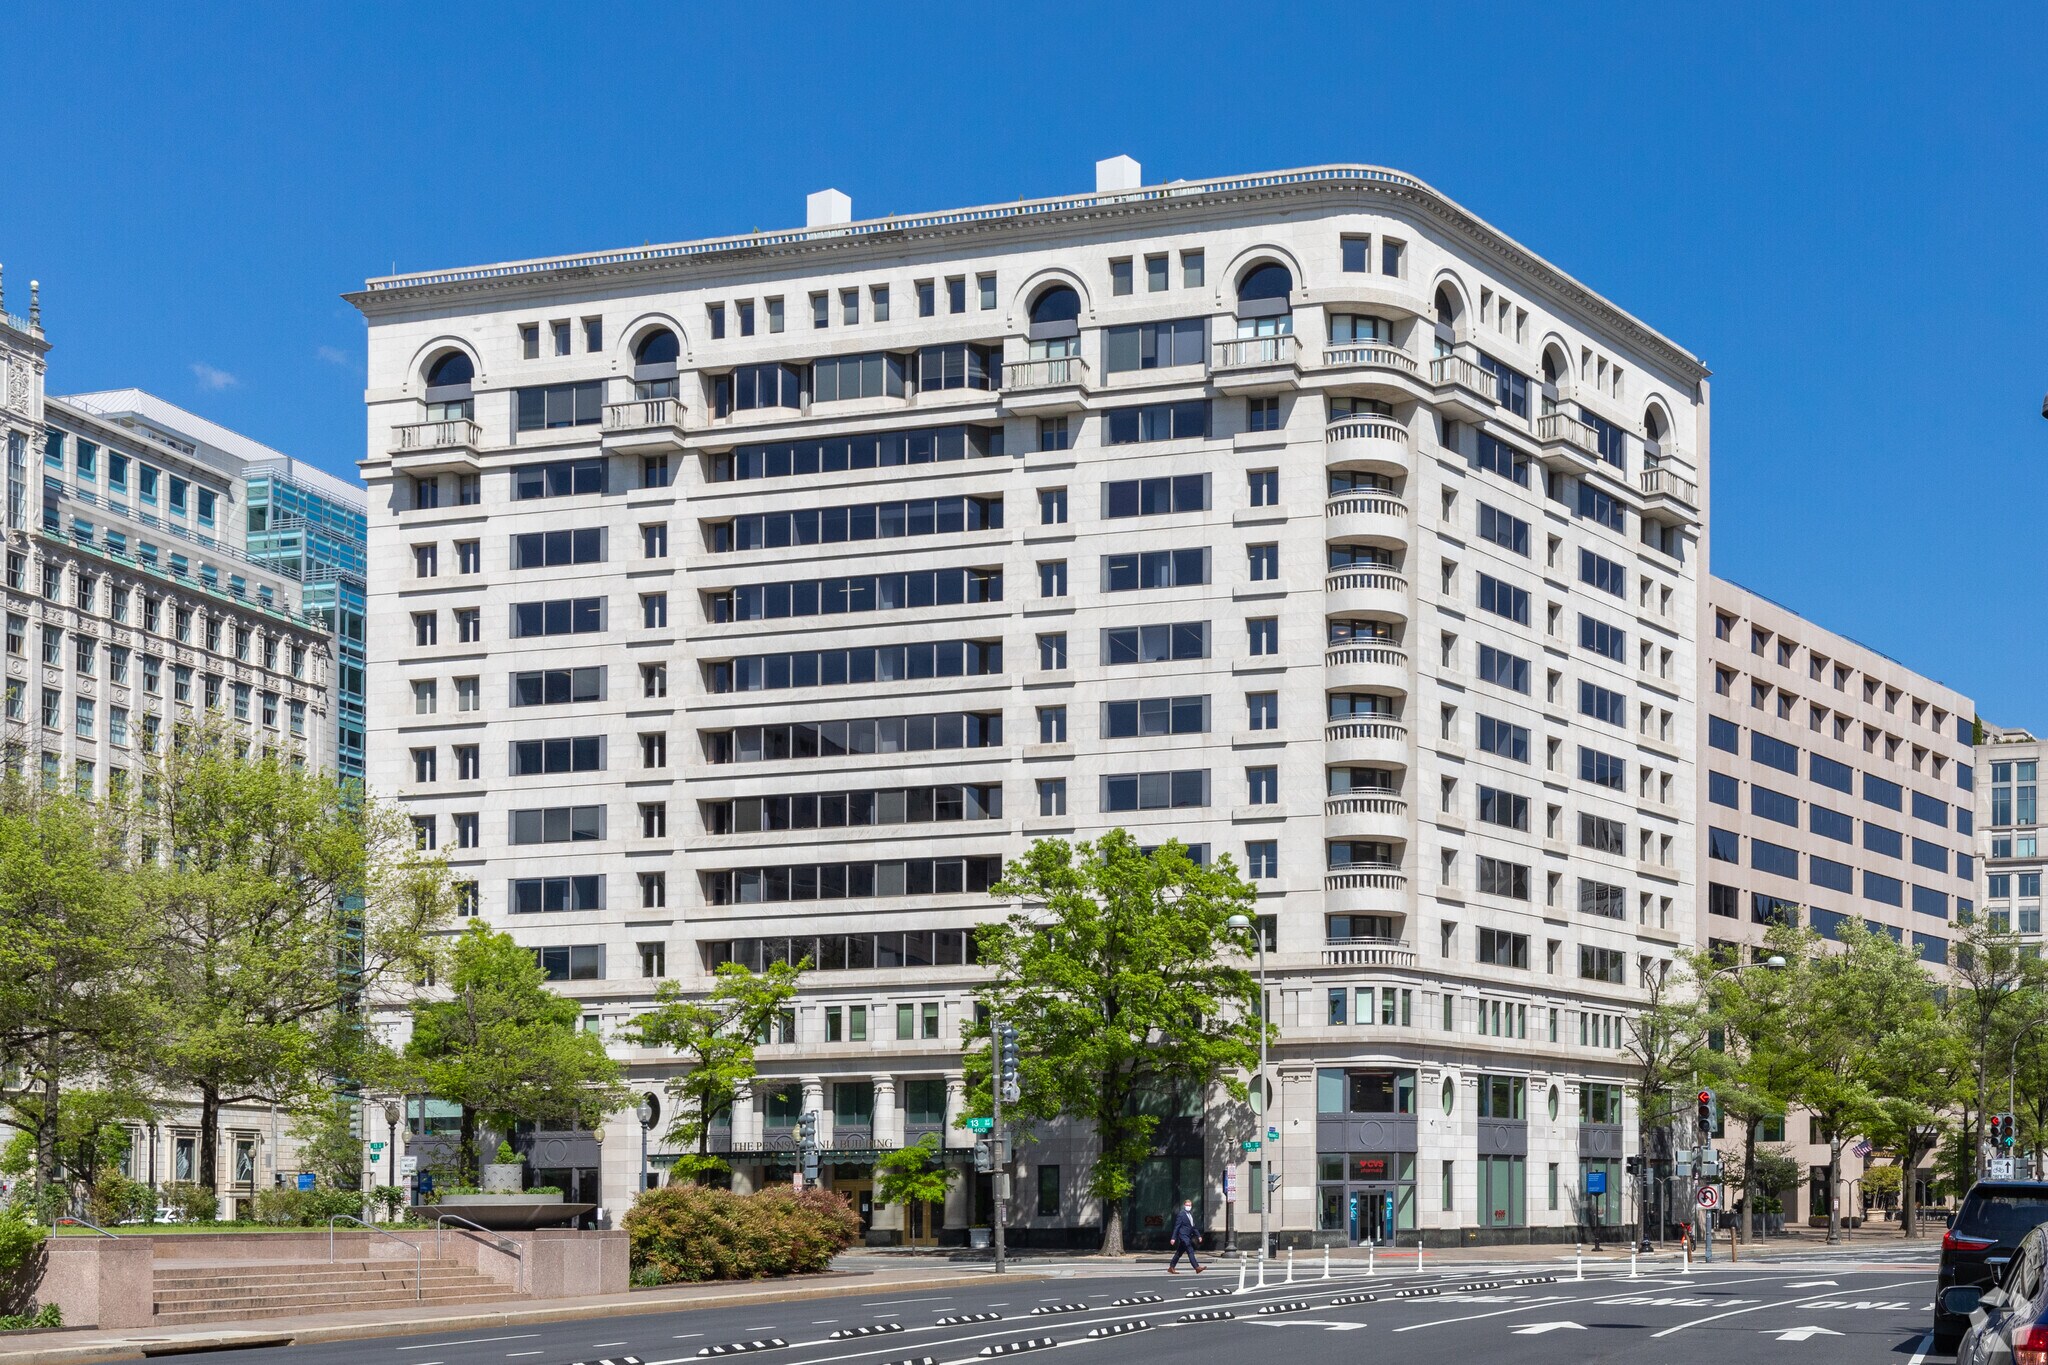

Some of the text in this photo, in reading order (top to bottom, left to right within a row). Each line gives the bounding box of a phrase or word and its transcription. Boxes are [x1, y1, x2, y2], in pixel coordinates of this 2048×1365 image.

[970, 1119, 979, 1127] 13
[733, 1138, 893, 1151] THE PENNSYNIA BUILDING
[1367, 1160, 1384, 1168] CVS
[1593, 1297, 1762, 1307] ONLY
